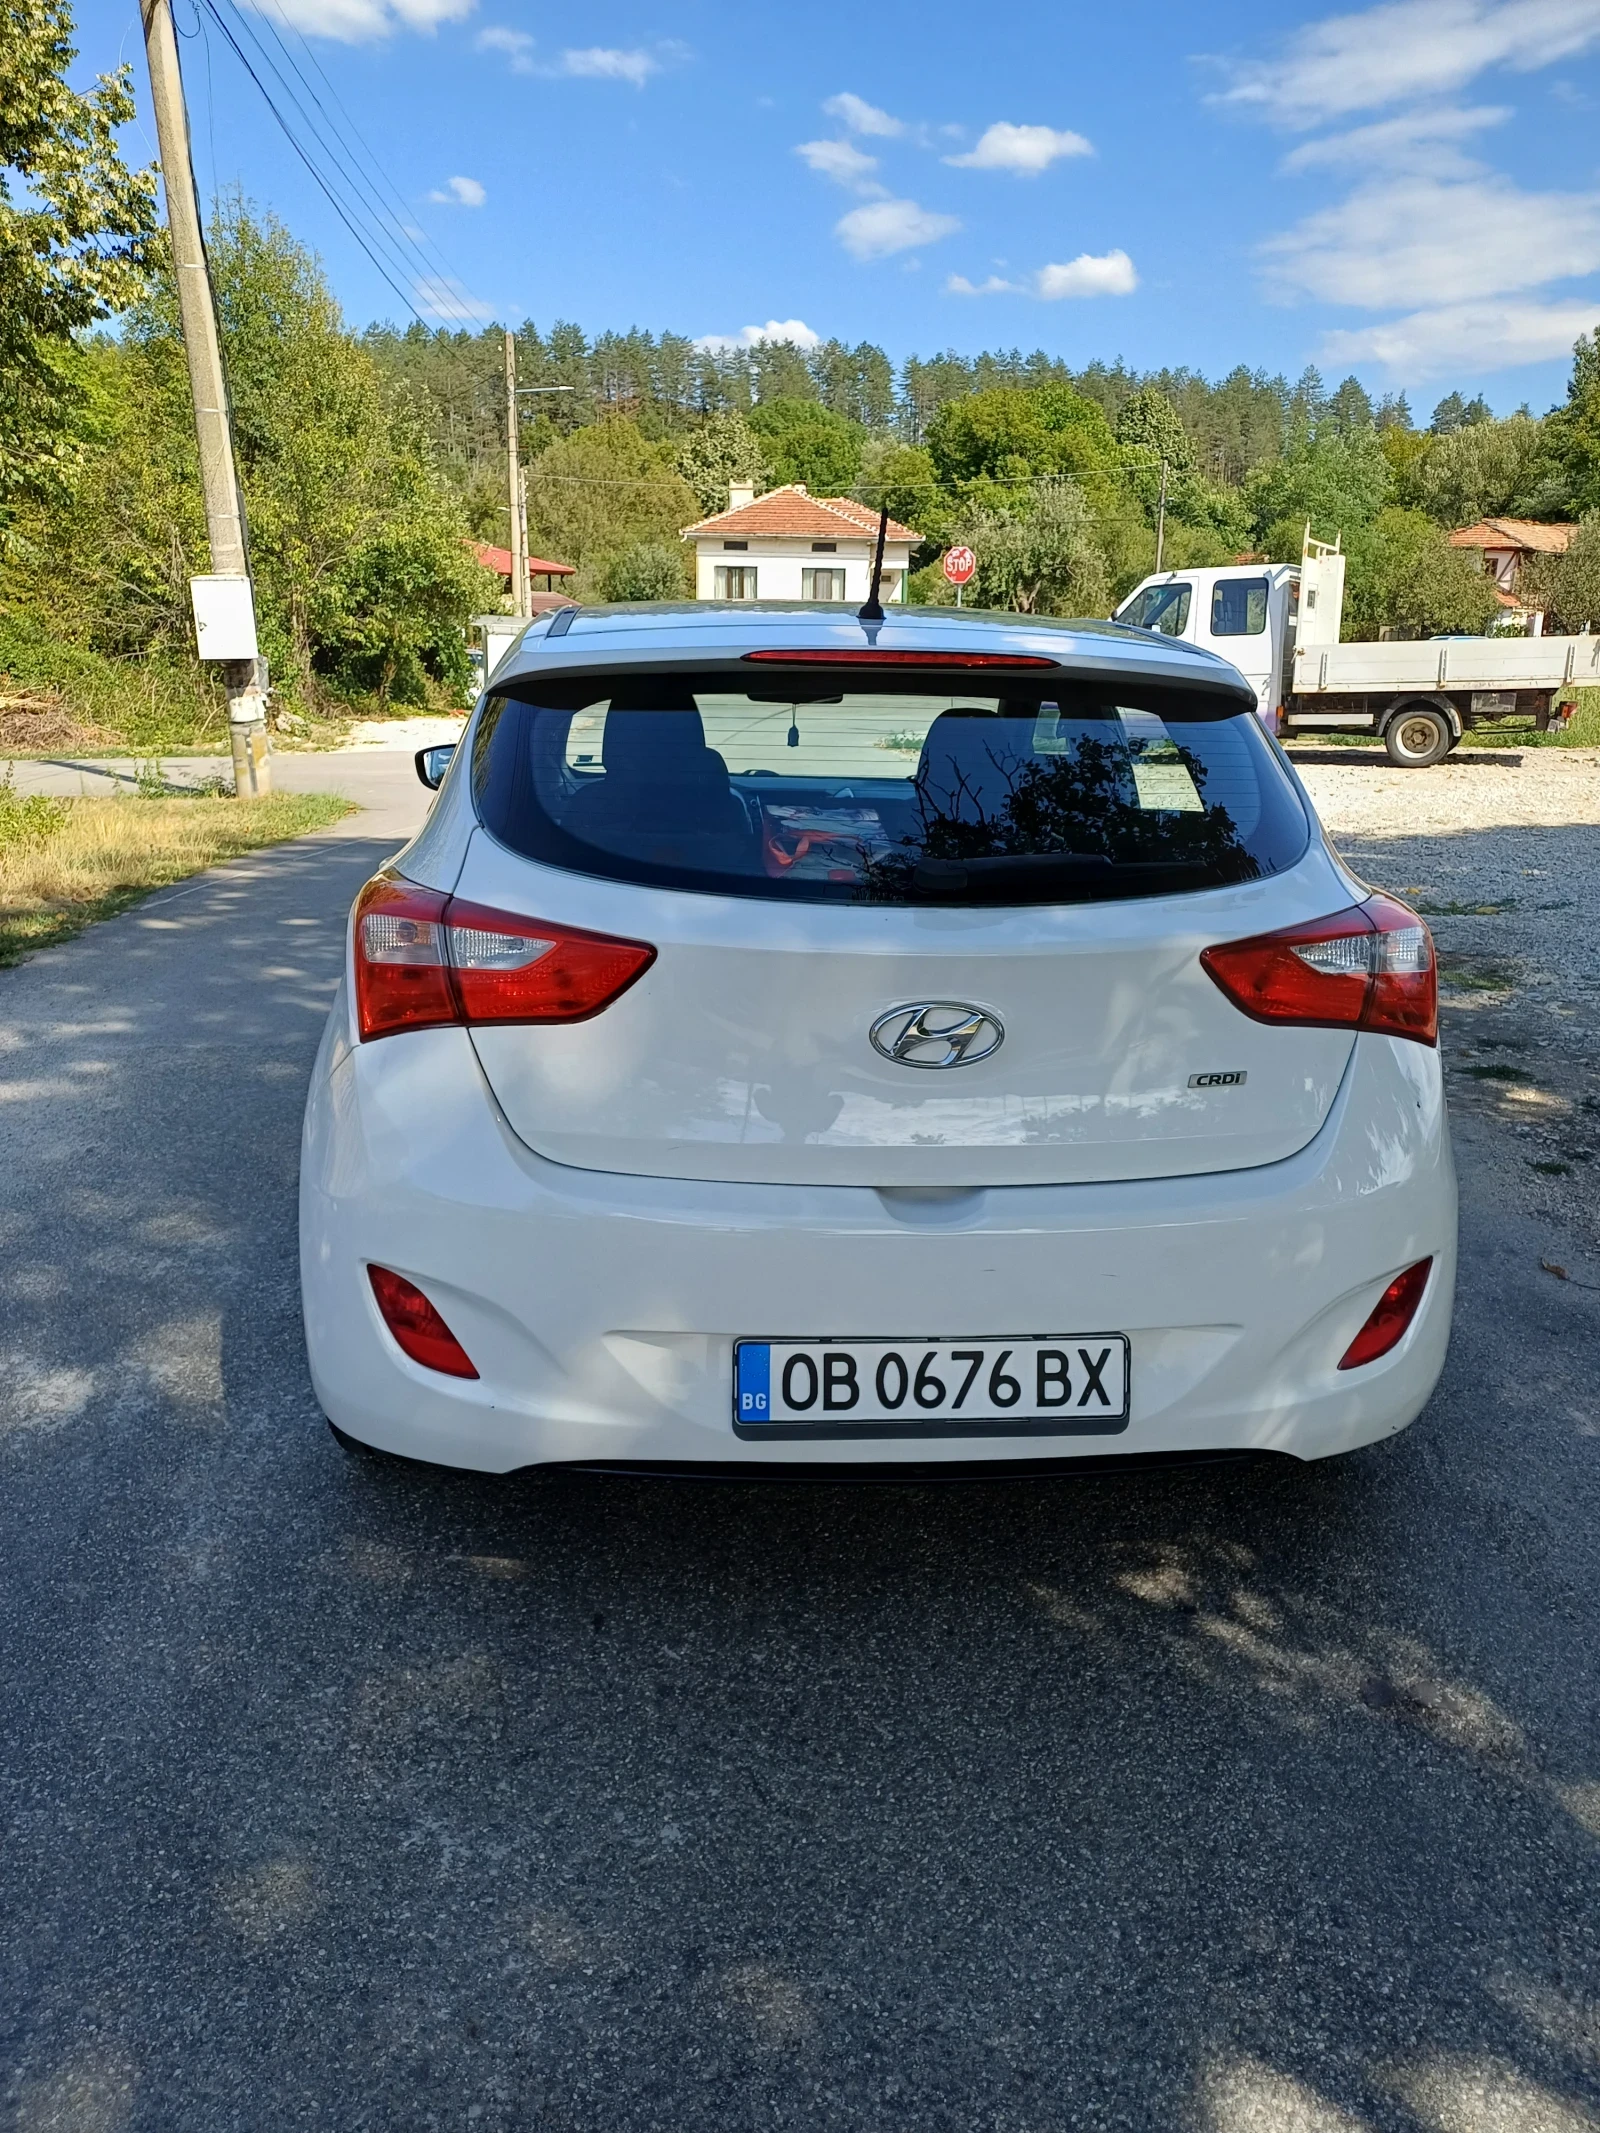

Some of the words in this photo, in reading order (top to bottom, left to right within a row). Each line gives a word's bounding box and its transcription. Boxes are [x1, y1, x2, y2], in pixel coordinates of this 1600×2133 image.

[947, 557, 972, 572] STOP
[875, 1350, 1022, 1410] 0676
[1036, 1348, 1112, 1408] BX
[742, 1393, 767, 1411] BG
